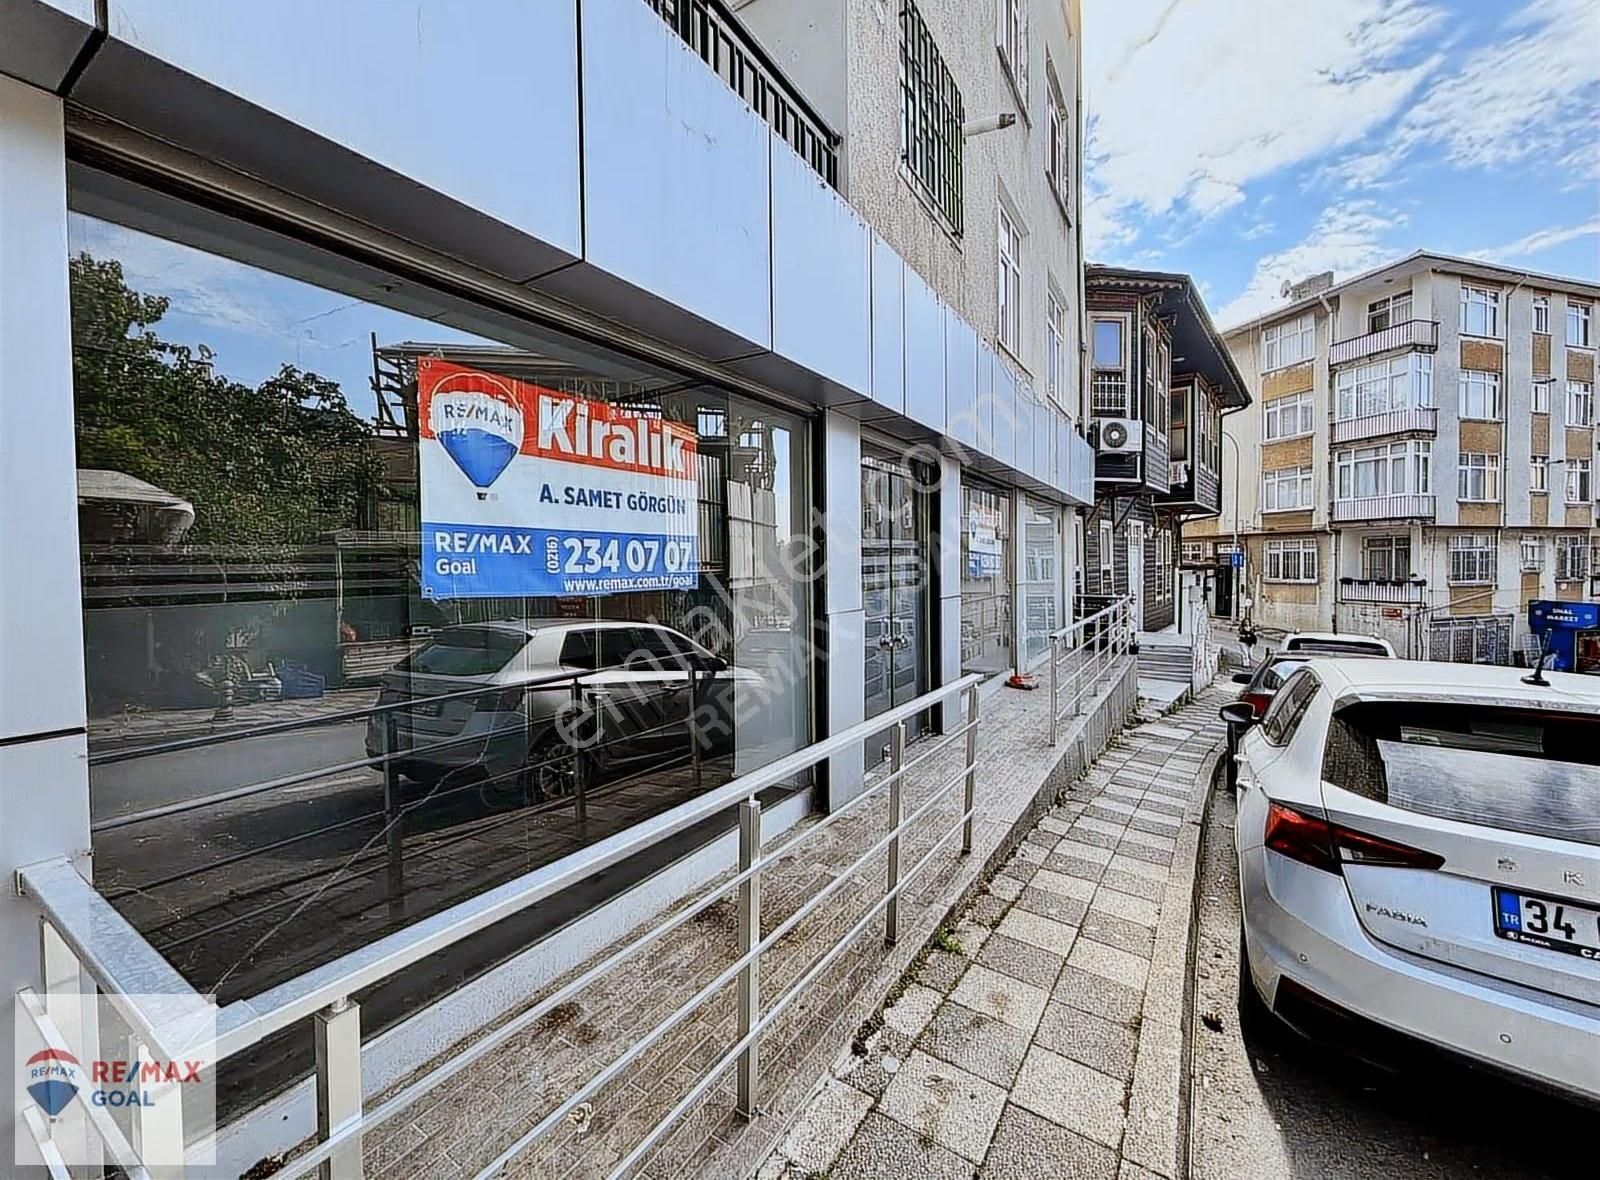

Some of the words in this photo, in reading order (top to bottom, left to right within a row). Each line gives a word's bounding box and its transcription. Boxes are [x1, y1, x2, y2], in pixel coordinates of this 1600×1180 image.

[444, 403, 513, 432] RE/MAX
[540, 483, 559, 504] A.
[564, 486, 622, 510] SAMET
[626, 491, 686, 515] GÖRGÜN
[434, 531, 532, 554] RE/MAX
[546, 536, 560, 574] (0216)
[563, 537, 621, 574] 234
[626, 539, 659, 573] 07
[664, 540, 692, 573] 07
[435, 557, 476, 575] Goal
[563, 574, 693, 592] www.remax.com.tr/goal
[1365, 903, 1429, 928] FABIA
[1502, 912, 1520, 925] TR
[1524, 899, 1576, 940] 34
